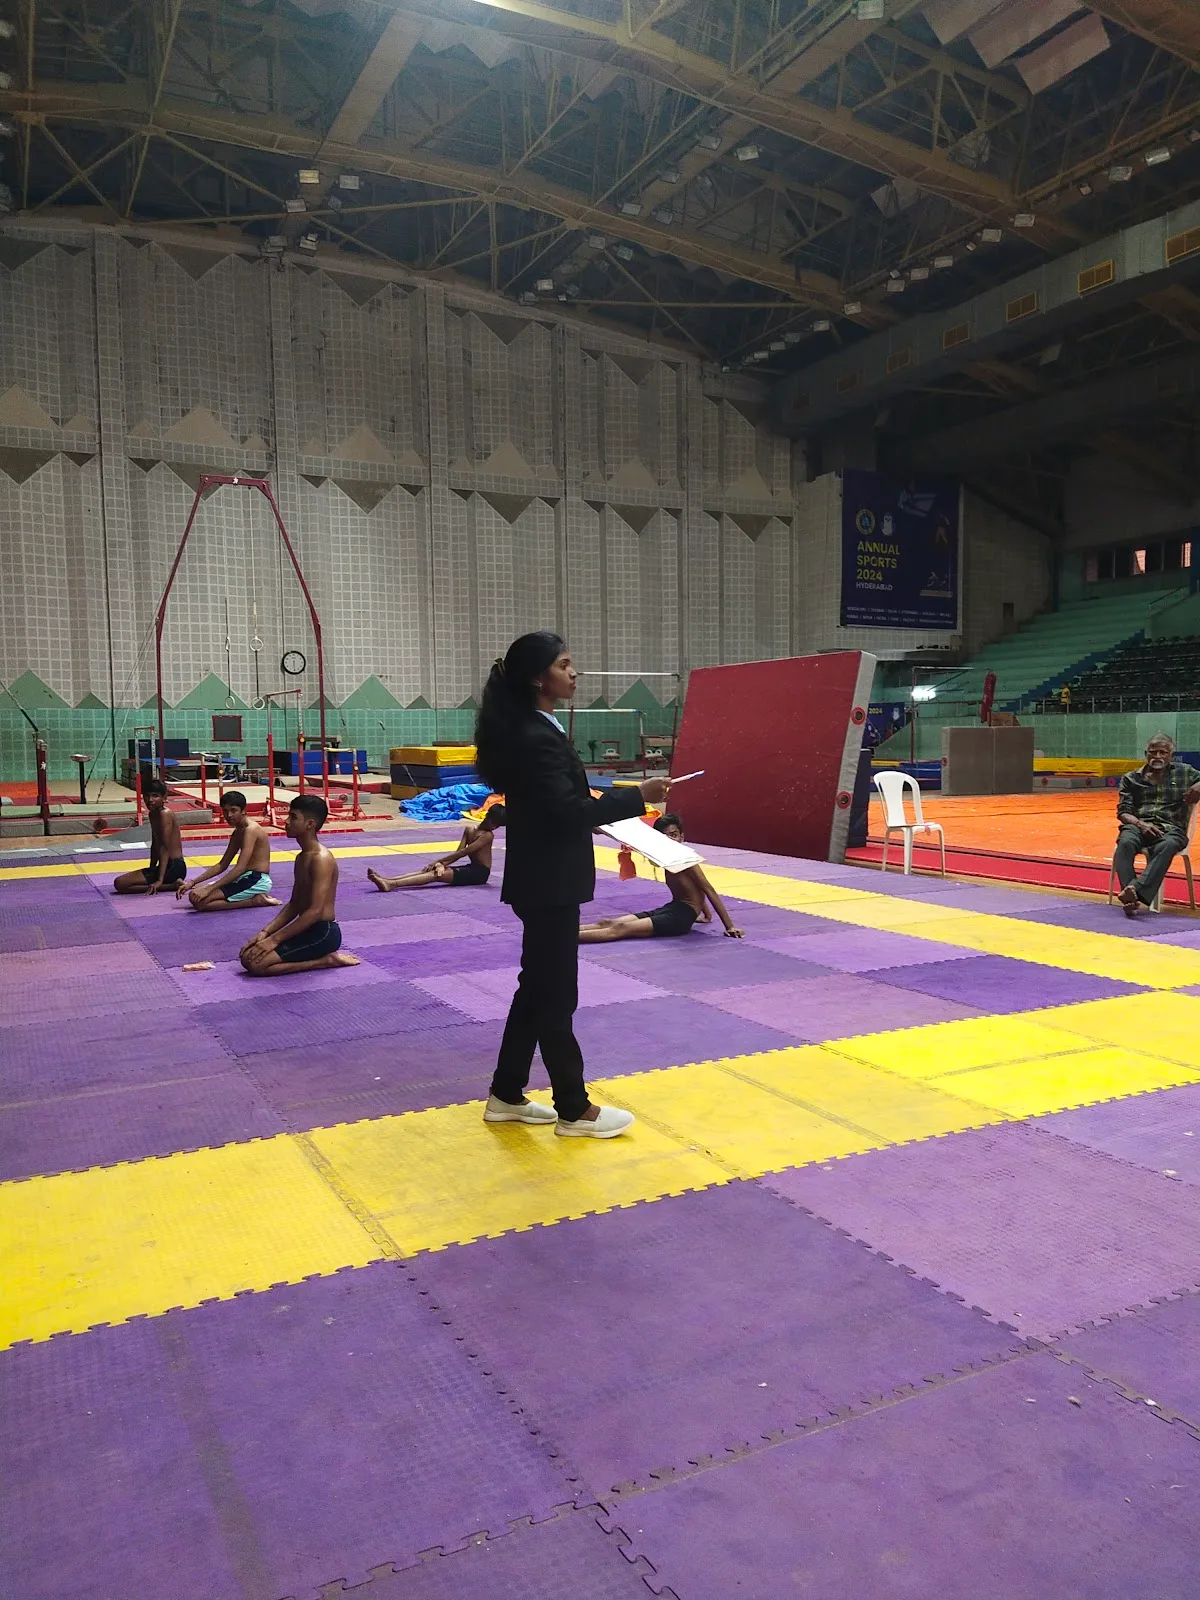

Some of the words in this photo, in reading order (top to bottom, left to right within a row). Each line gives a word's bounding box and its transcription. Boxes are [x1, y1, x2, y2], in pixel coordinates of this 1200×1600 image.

[857, 541, 901, 555] ANNUAL
[857, 555, 897, 569] SPORTS
[856, 568, 883, 581] 2024
[856, 582, 893, 591] HYDERABAD
